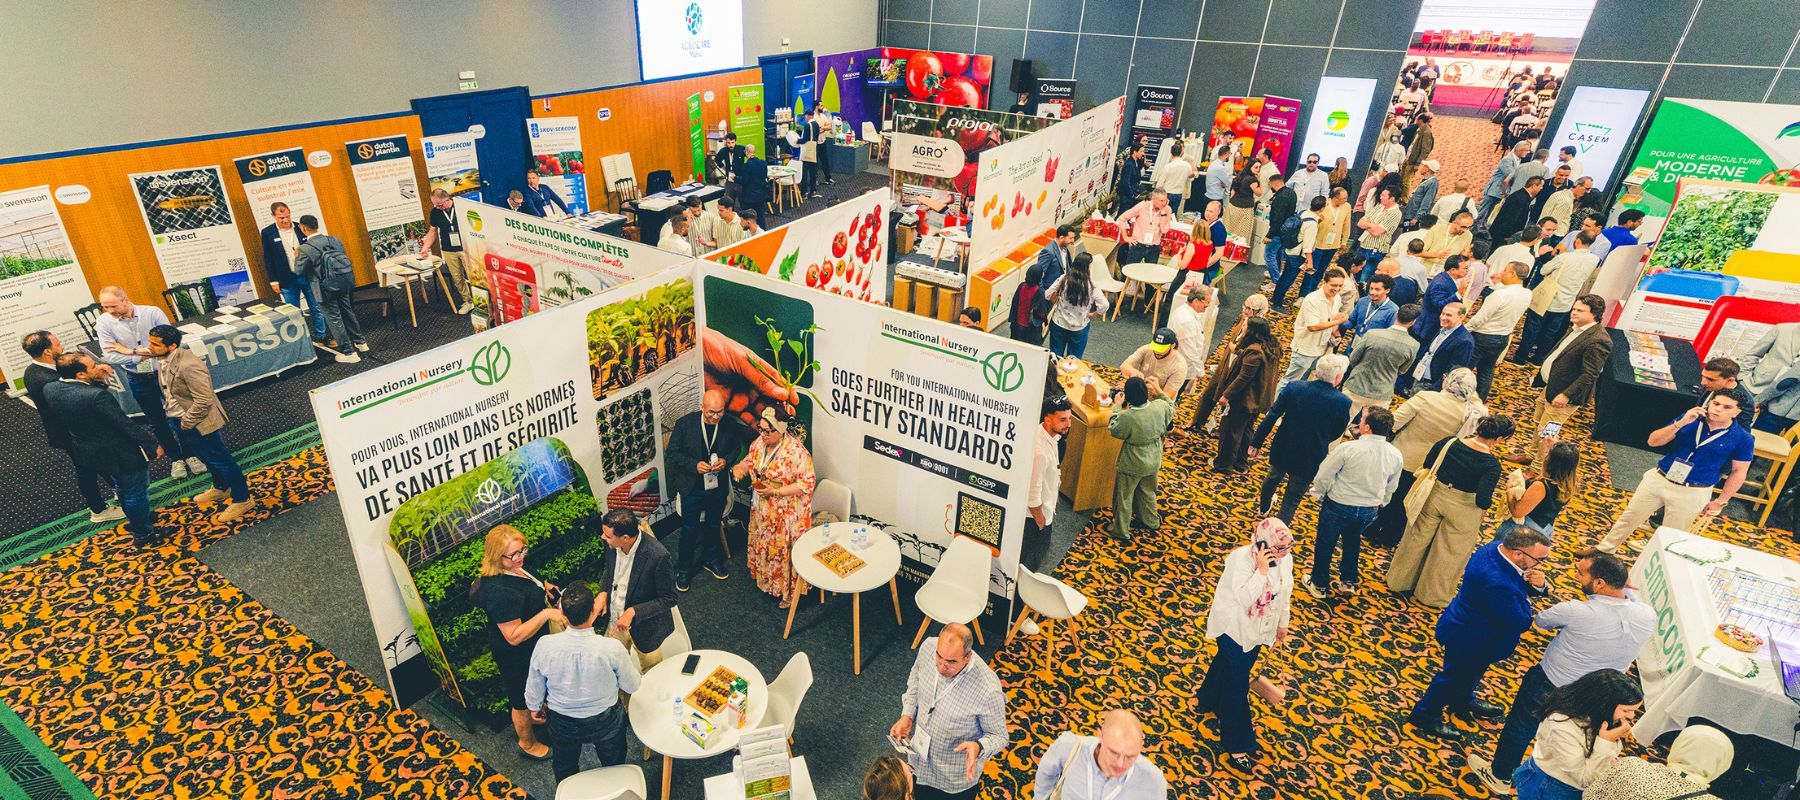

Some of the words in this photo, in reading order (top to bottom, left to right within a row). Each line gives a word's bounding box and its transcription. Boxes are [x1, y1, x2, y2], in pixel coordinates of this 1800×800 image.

[1049, 84, 1071, 93] Source
[1150, 91, 1173, 100] Source
[946, 117, 999, 133] projar
[1568, 132, 1609, 143] CASEM
[374, 141, 394, 151] dutch
[375, 147, 400, 157] plantin
[266, 155, 290, 165] dutch
[1649, 150, 1676, 158] POUR
[1677, 152, 1697, 160] UNE
[1697, 154, 1764, 166] AGRICULTURE
[268, 161, 296, 173] plantin
[1653, 160, 1749, 178] MODERNE
[1649, 172, 1660, 182] &
[4, 194, 48, 208] svensson
[168, 232, 198, 243] Xsect
[504, 218, 521, 230] DES
[522, 222, 572, 244] SOLUTIONS
[573, 236, 630, 258] COMPLÈTES
[516, 235, 538, 246] CHAQUE
[560, 246, 577, 256] VOTRE
[578, 252, 601, 263] CULTURE
[46, 277, 75, 288] Luxous
[881, 320, 940, 345] International
[941, 336, 980, 358] Nursery
[337, 372, 418, 411] International
[419, 358, 464, 381] Nursery
[891, 368, 904, 382] FOR
[906, 373, 921, 387] YOU
[922, 378, 980, 406] INTERNATIONAL
[982, 396, 1020, 417] NURSERY
[832, 367, 863, 392] GOES
[866, 378, 924, 413] FURTHER
[928, 397, 944, 419] IN
[948, 403, 1002, 437] HEALTH
[1005, 421, 1016, 442] &
[351, 444, 379, 466] POUR
[379, 433, 409, 454] VOUS,
[409, 405, 474, 441] INTERNATIONAL
[475, 390, 510, 414] NURSERY
[356, 465, 381, 490] VA
[382, 446, 422, 479] PLUS
[424, 430, 460, 461] LOIN
[462, 413, 500, 445] DANS
[502, 402, 524, 428] LES
[526, 380, 576, 417] NORMES
[831, 388, 894, 430] SAFETY
[898, 410, 1014, 470] STANDARDS
[874, 440, 901, 458] Sedex
[364, 488, 394, 522] DE
[395, 453, 455, 505] SANTÉ
[460, 448, 478, 474] ET
[482, 437, 502, 463] DE
[507, 397, 579, 452] SÉCURITÉ
[934, 463, 949, 475] 9001
[976, 477, 996, 489] GSPP
[466, 502, 501, 524] International
